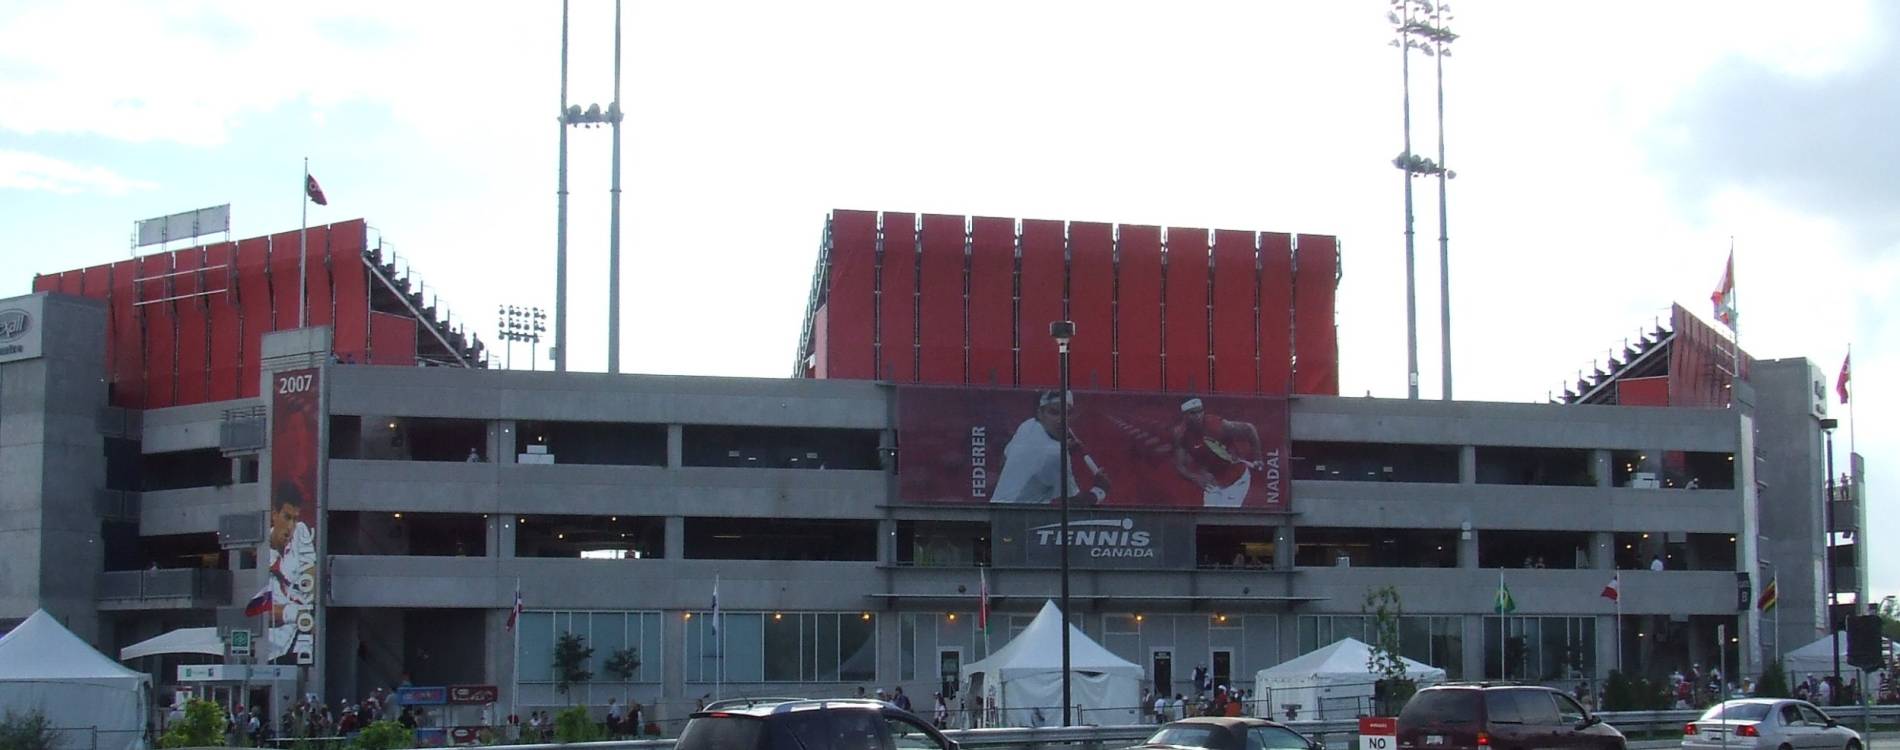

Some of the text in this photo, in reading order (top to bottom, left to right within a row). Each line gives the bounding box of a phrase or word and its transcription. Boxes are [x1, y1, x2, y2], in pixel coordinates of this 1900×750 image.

[279, 374, 313, 394] 2007
[972, 426, 986, 497] FEDERER
[1267, 448, 1280, 504] NADAL
[1090, 547, 1154, 557] CANADA
[1369, 738, 1386, 749] NO
